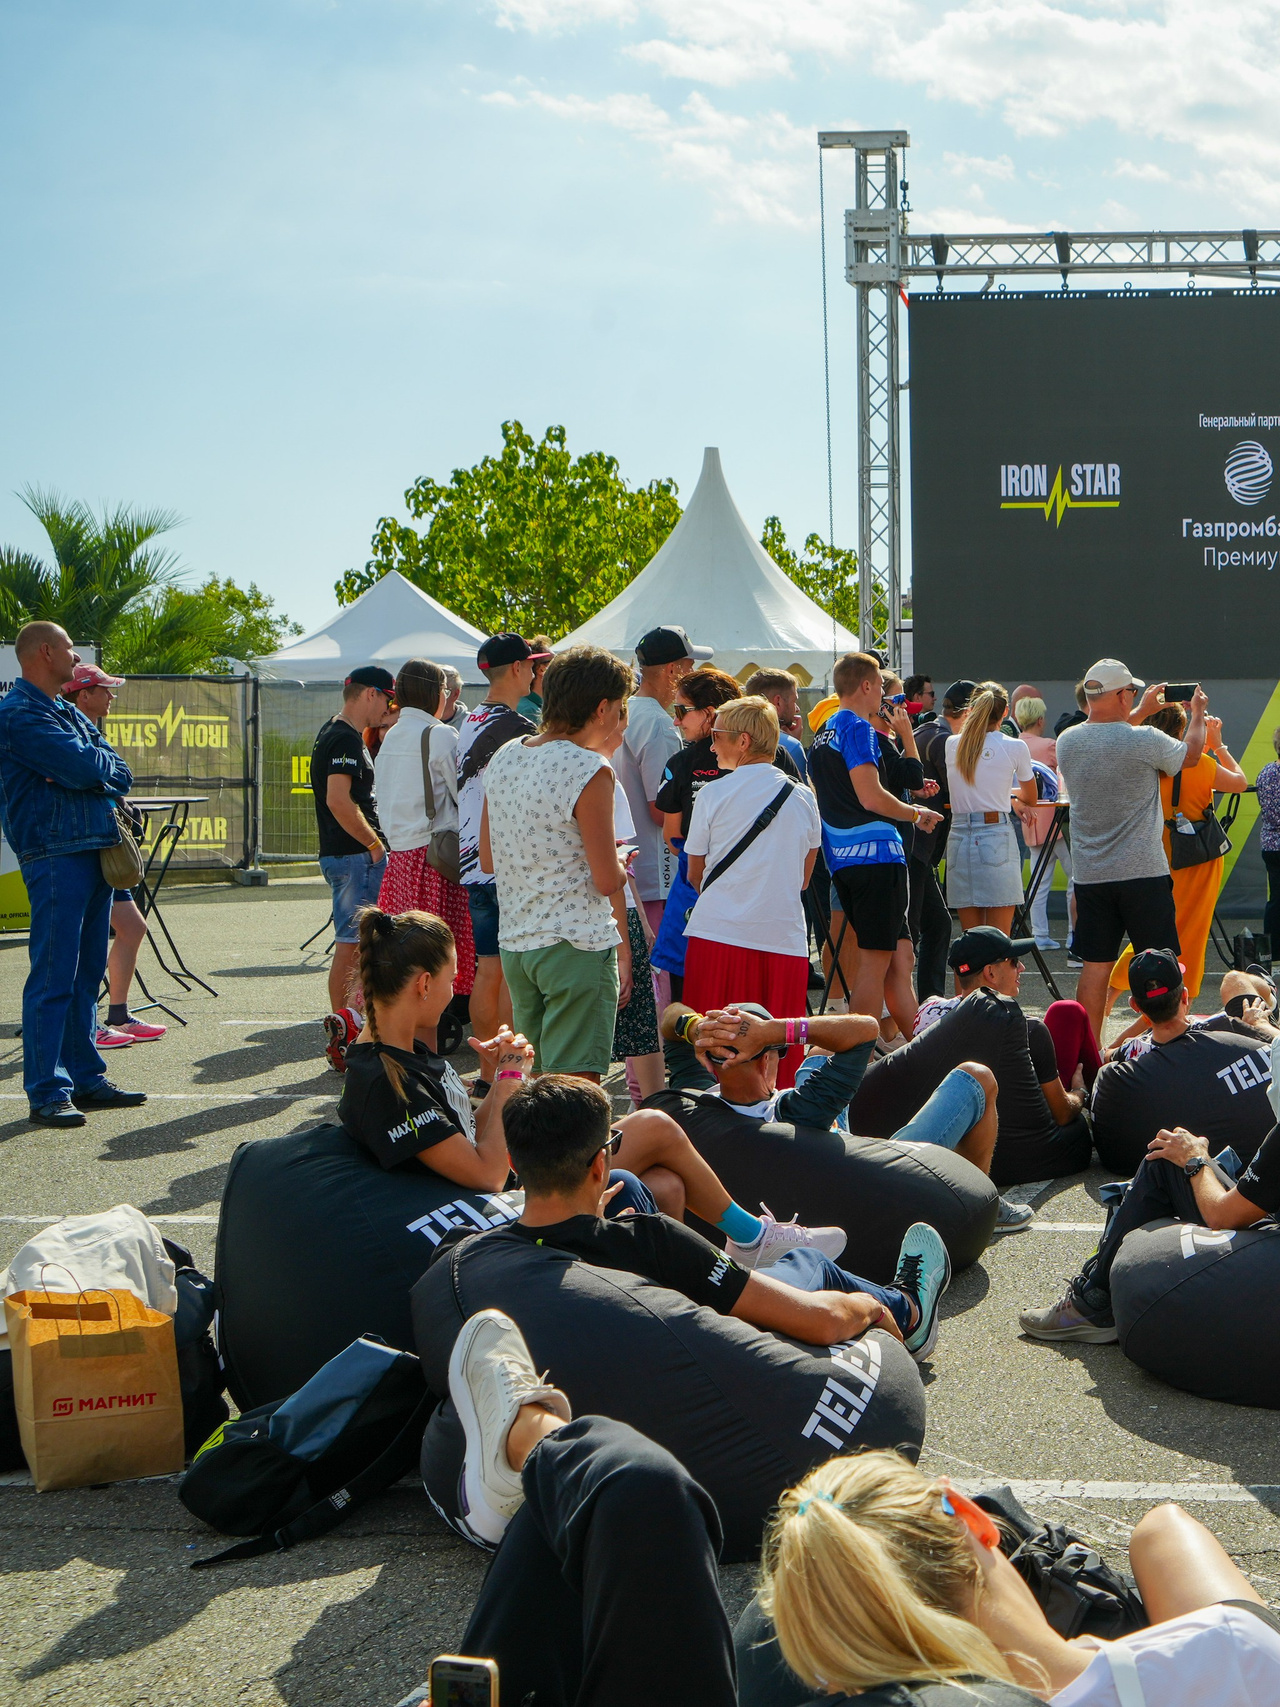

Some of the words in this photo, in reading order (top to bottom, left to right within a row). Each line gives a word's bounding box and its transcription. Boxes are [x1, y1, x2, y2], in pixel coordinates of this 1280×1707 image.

[1198, 412, 1256, 431] Генеральный
[1001, 464, 1047, 497] IRON
[1071, 463, 1121, 496] STAR
[105, 723, 157, 747] STAR
[181, 724, 229, 748] IRON
[78, 1392, 158, 1412] МАГНИТ
